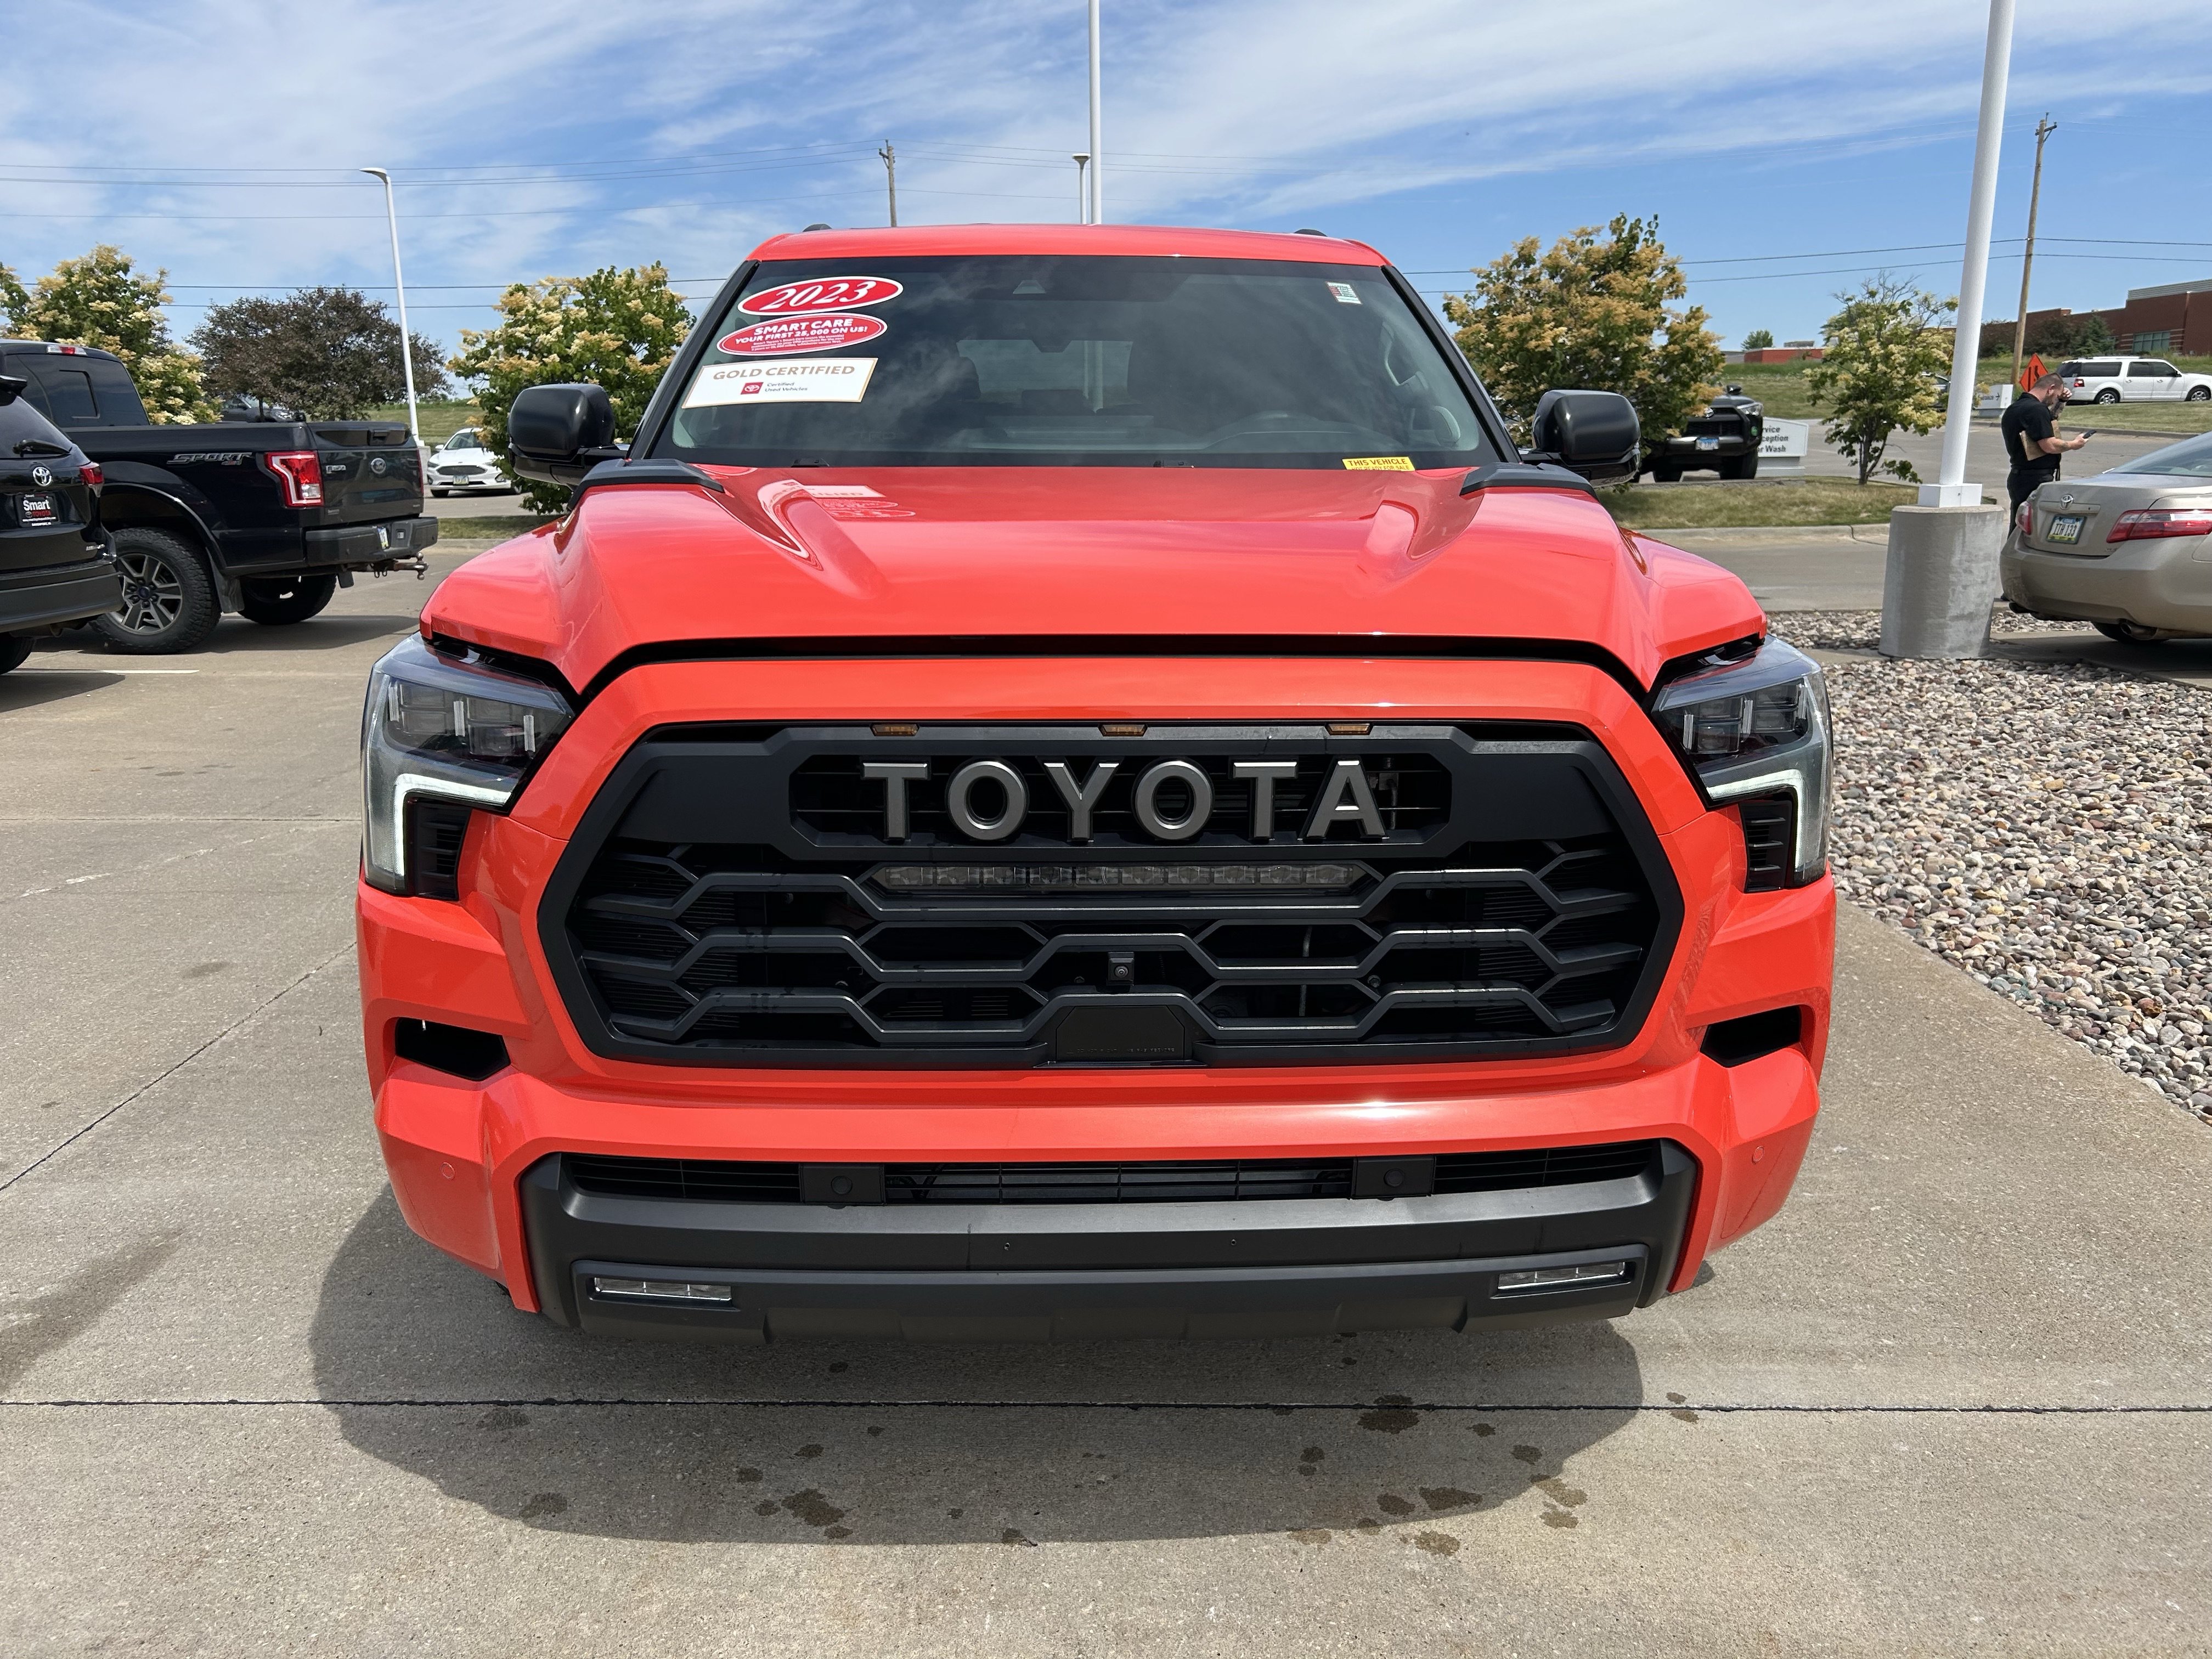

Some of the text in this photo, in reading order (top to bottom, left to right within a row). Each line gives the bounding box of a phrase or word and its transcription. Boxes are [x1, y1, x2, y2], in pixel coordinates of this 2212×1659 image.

[759, 281, 877, 311] 2023
[753, 318, 854, 335] SMART CARE
[735, 335, 765, 344] YOUR
[765, 331, 794, 340] FIRST
[713, 366, 855, 380] GOLD CERTIFIED
[166, 452, 252, 465] SPORT
[22, 499, 50, 511] Smart
[861, 759, 1389, 842] TOYOTA
